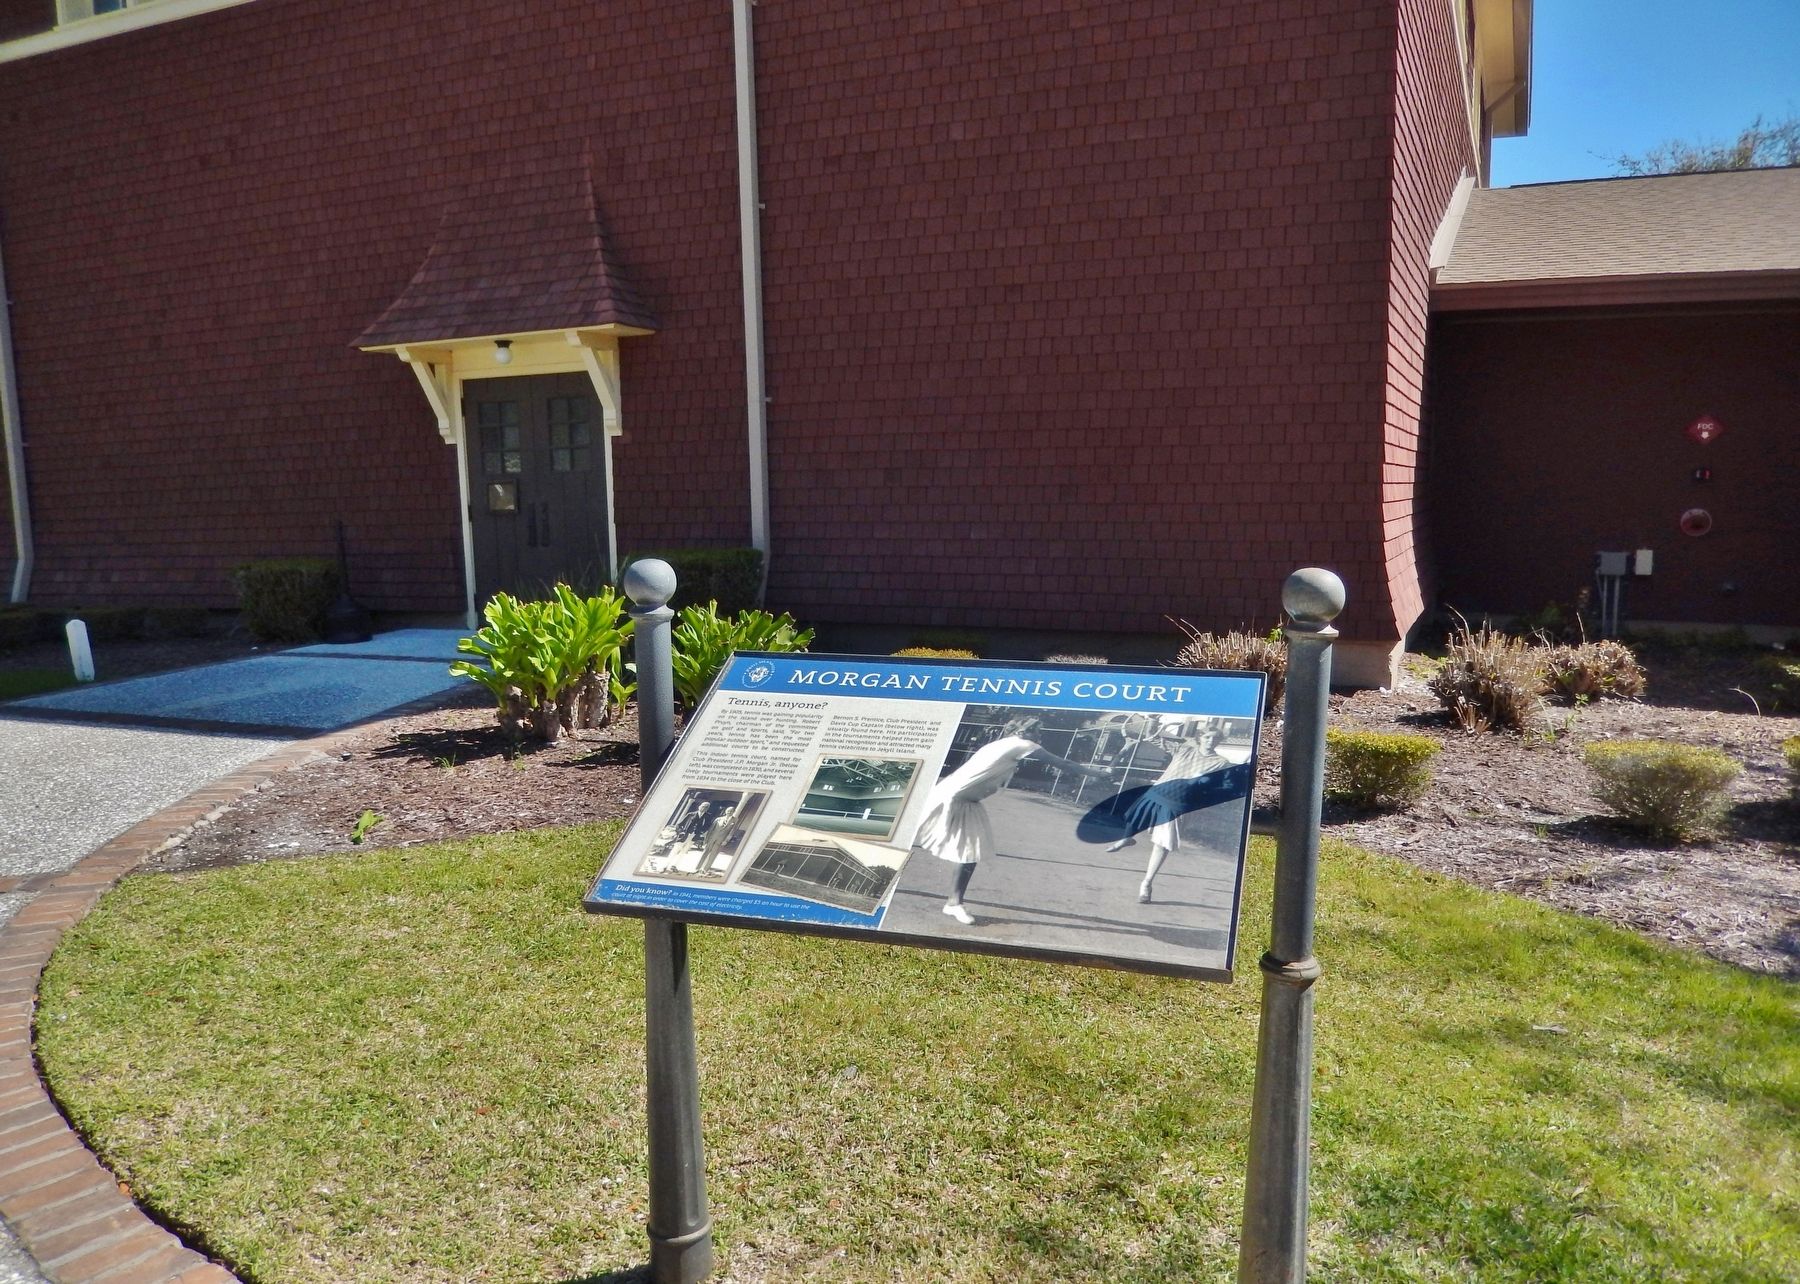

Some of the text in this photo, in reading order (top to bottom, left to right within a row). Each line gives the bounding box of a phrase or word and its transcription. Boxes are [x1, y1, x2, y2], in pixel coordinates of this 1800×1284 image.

[788, 670, 931, 690] MORGAN
[942, 675, 1062, 697] TENNIS
[1073, 683, 1192, 703] COURT
[728, 697, 828, 711] Tennis, anyone?
[615, 884, 630, 892] Did
[645, 887, 673, 896] know?
